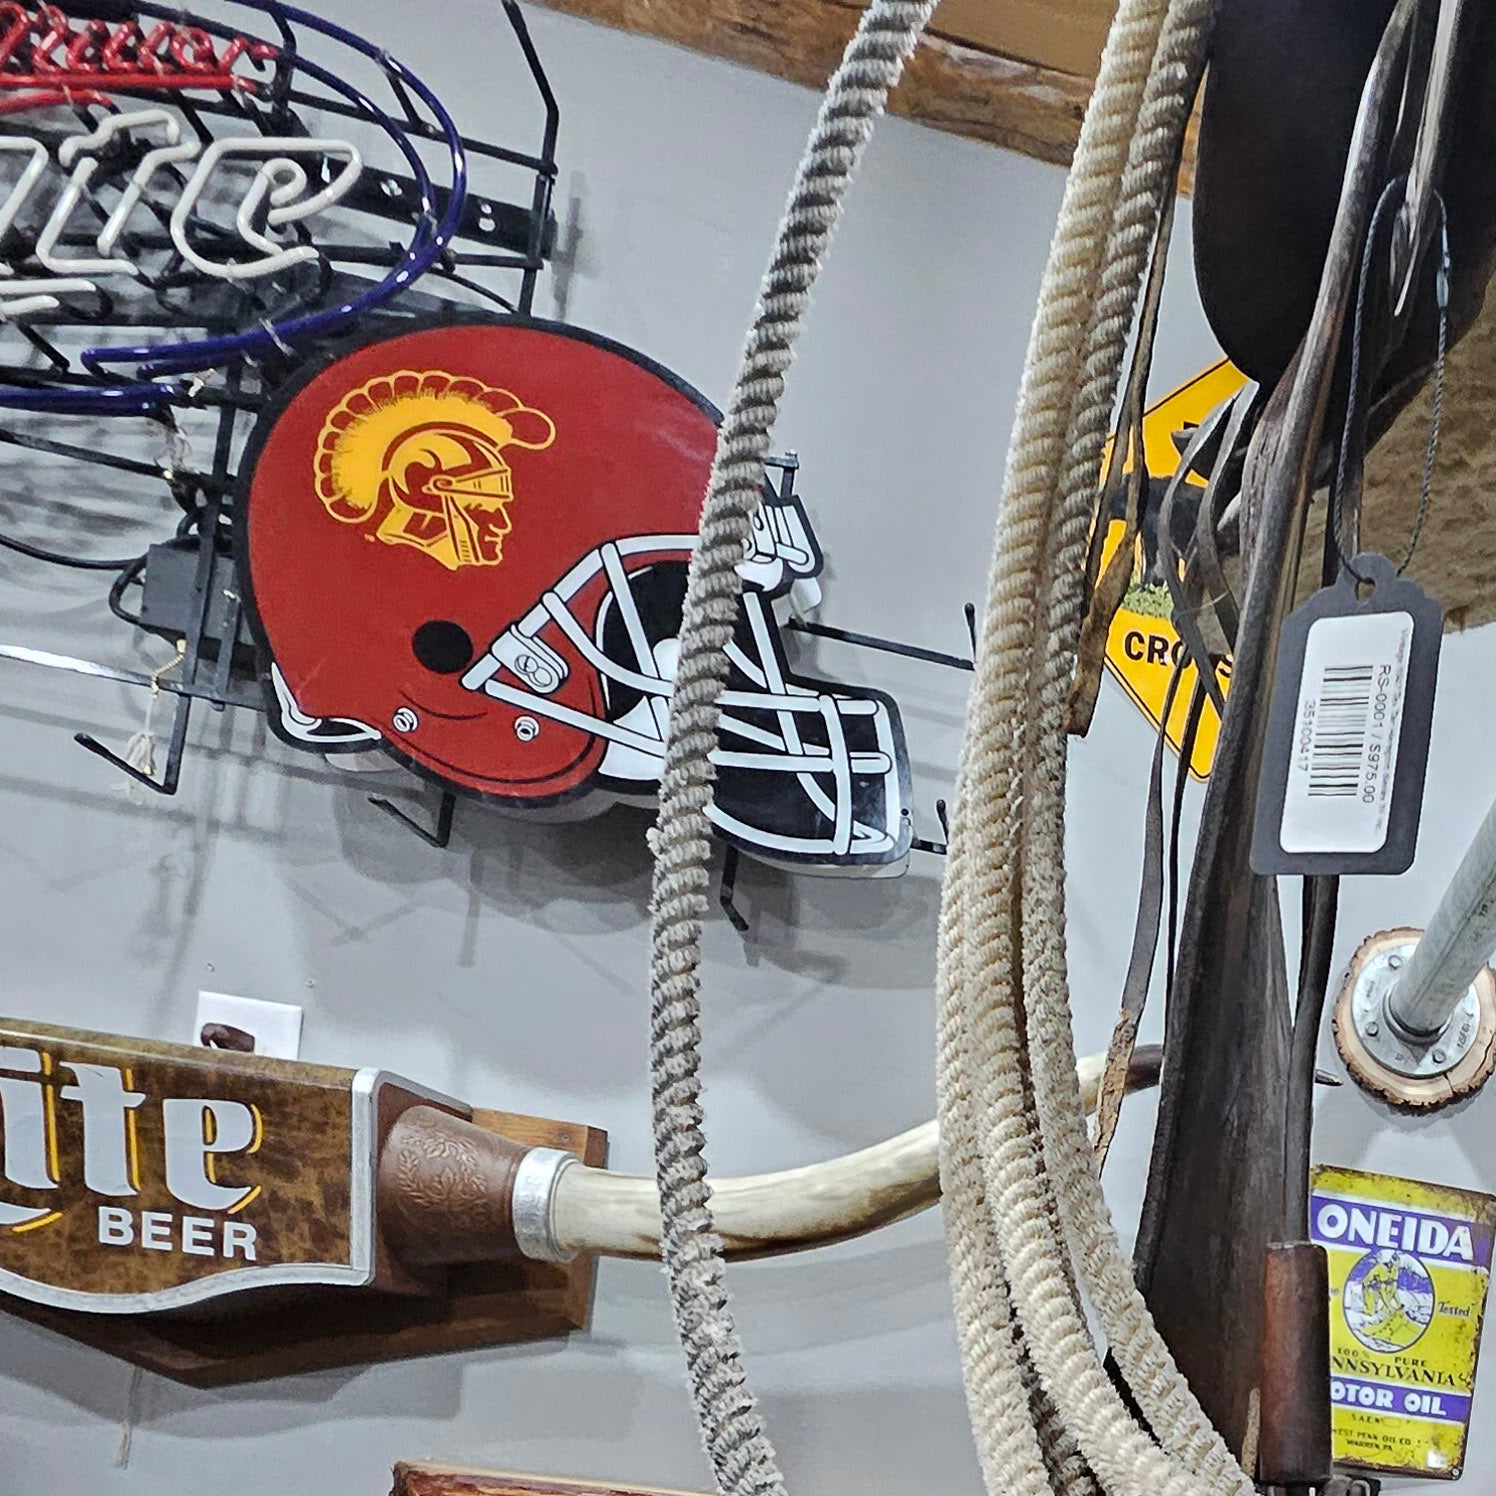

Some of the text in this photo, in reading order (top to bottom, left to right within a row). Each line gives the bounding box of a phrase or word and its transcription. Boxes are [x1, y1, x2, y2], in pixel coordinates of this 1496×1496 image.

[0, 1045, 262, 1228] ite
[98, 1206, 257, 1261] BEER
[1317, 1202, 1474, 1261] ONEIDA
[1437, 1301, 1471, 1318] Tested
[1332, 1355, 1457, 1387] NNSYLVANIA
[1394, 1356, 1428, 1368] PURE
[1331, 1380, 1447, 1416] OTOR OIL
